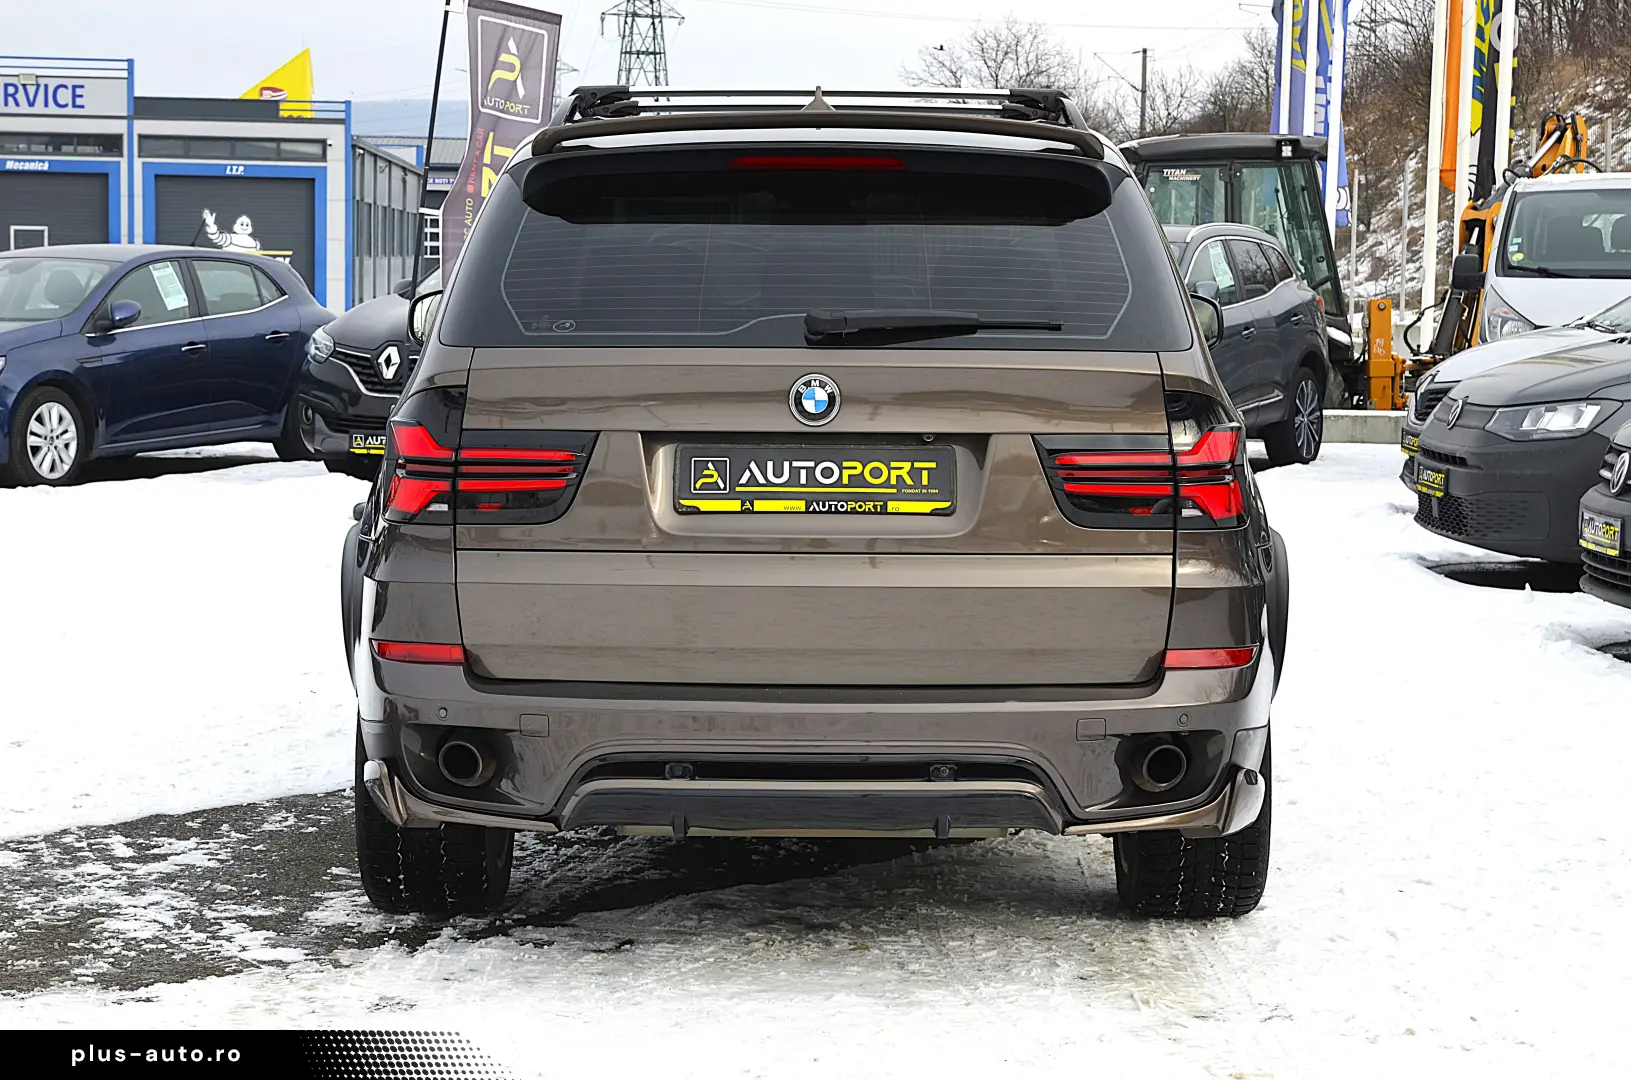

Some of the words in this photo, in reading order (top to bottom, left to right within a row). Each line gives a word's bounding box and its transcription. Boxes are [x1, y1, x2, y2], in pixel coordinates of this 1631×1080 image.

[3, 83, 86, 109] RVICE
[468, 160, 477, 184] RENT
[475, 127, 484, 149] CAR
[225, 165, 245, 175] I.T.P.
[464, 198, 473, 227] AUTO
[798, 379, 834, 394] BMW
[738, 460, 937, 486] AUTOPORT
[808, 501, 884, 513] AUTOPORT
[1588, 520, 1619, 541] AUTOPORT
